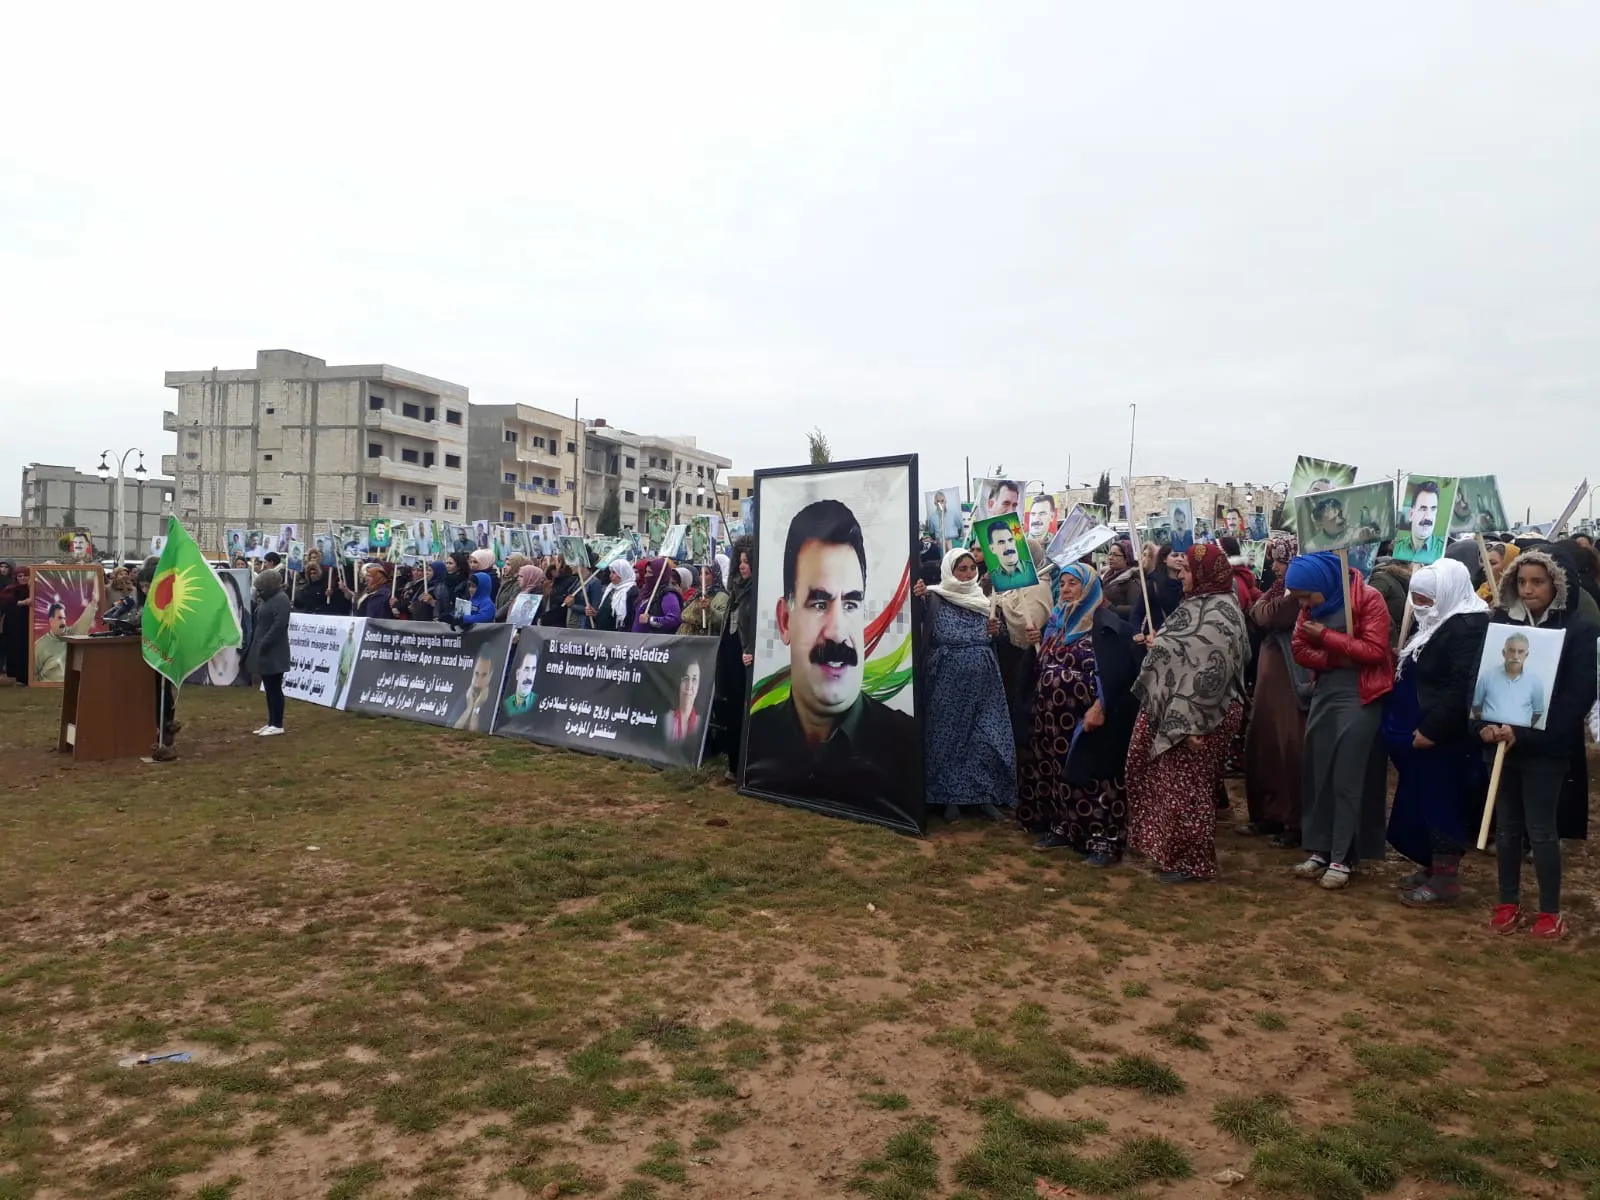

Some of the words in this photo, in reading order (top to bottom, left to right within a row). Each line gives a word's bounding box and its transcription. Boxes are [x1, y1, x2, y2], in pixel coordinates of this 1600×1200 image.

[383, 634, 391, 644] me
[549, 639, 558, 653] Bi
[560, 641, 582, 655] sekna
[394, 649, 400, 660] bi
[419, 652, 432, 667] Apo
[441, 654, 458, 666] azad
[564, 661, 594, 680] komplo
[632, 668, 642, 684] in
[568, 697, 591, 716] مقاومة
